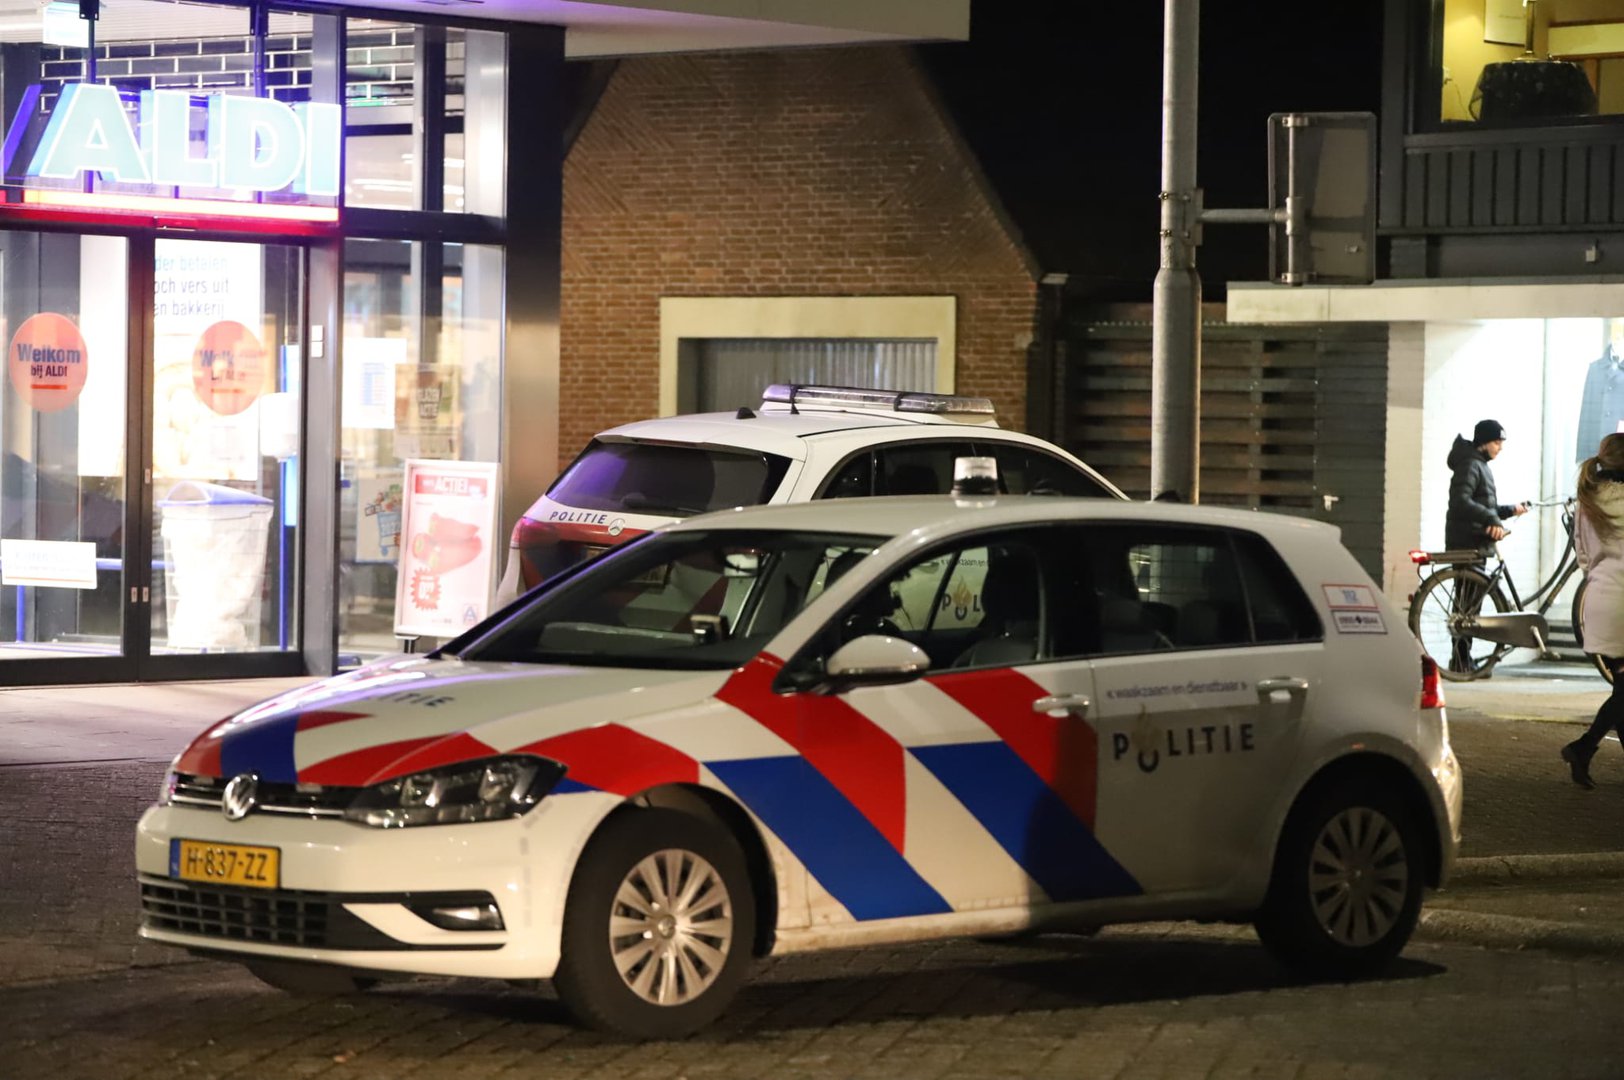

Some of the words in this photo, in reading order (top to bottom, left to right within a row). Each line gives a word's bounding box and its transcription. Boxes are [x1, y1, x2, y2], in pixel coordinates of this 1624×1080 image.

[27, 83, 341, 196] ALDI
[181, 279, 207, 293] vers
[213, 277, 229, 293] uit
[172, 299, 224, 319] bakkerij
[17, 343, 80, 363] Welkom
[31, 365, 43, 379] bij
[550, 511, 608, 524] POLITIE
[1113, 723, 1255, 773] POLITIE
[186, 846, 267, 881] H-837-ZZ
